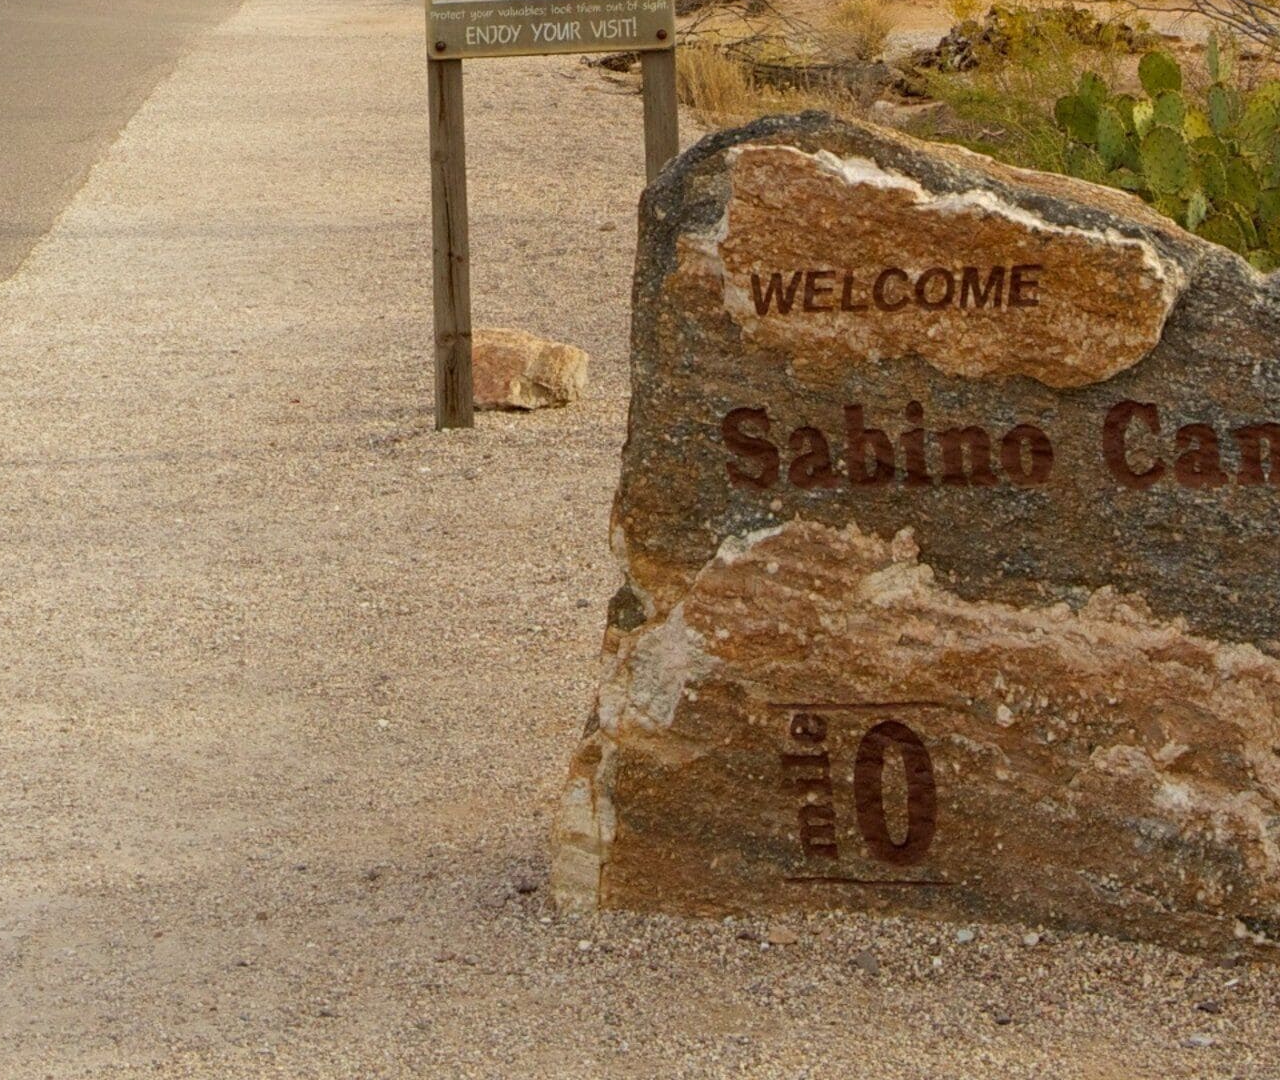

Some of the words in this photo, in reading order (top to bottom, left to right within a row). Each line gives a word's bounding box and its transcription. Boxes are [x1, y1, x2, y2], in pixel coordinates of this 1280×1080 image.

[465, 24, 522, 46] ENJOY
[530, 20, 582, 42] YOUR
[589, 16, 637, 39] VISIT!
[470, 9, 494, 22] your
[577, 2, 601, 13] them
[606, 2, 623, 12] out
[750, 263, 1044, 316] WELCOME
[720, 399, 1056, 491] Sabino
[853, 720, 938, 867] 0
